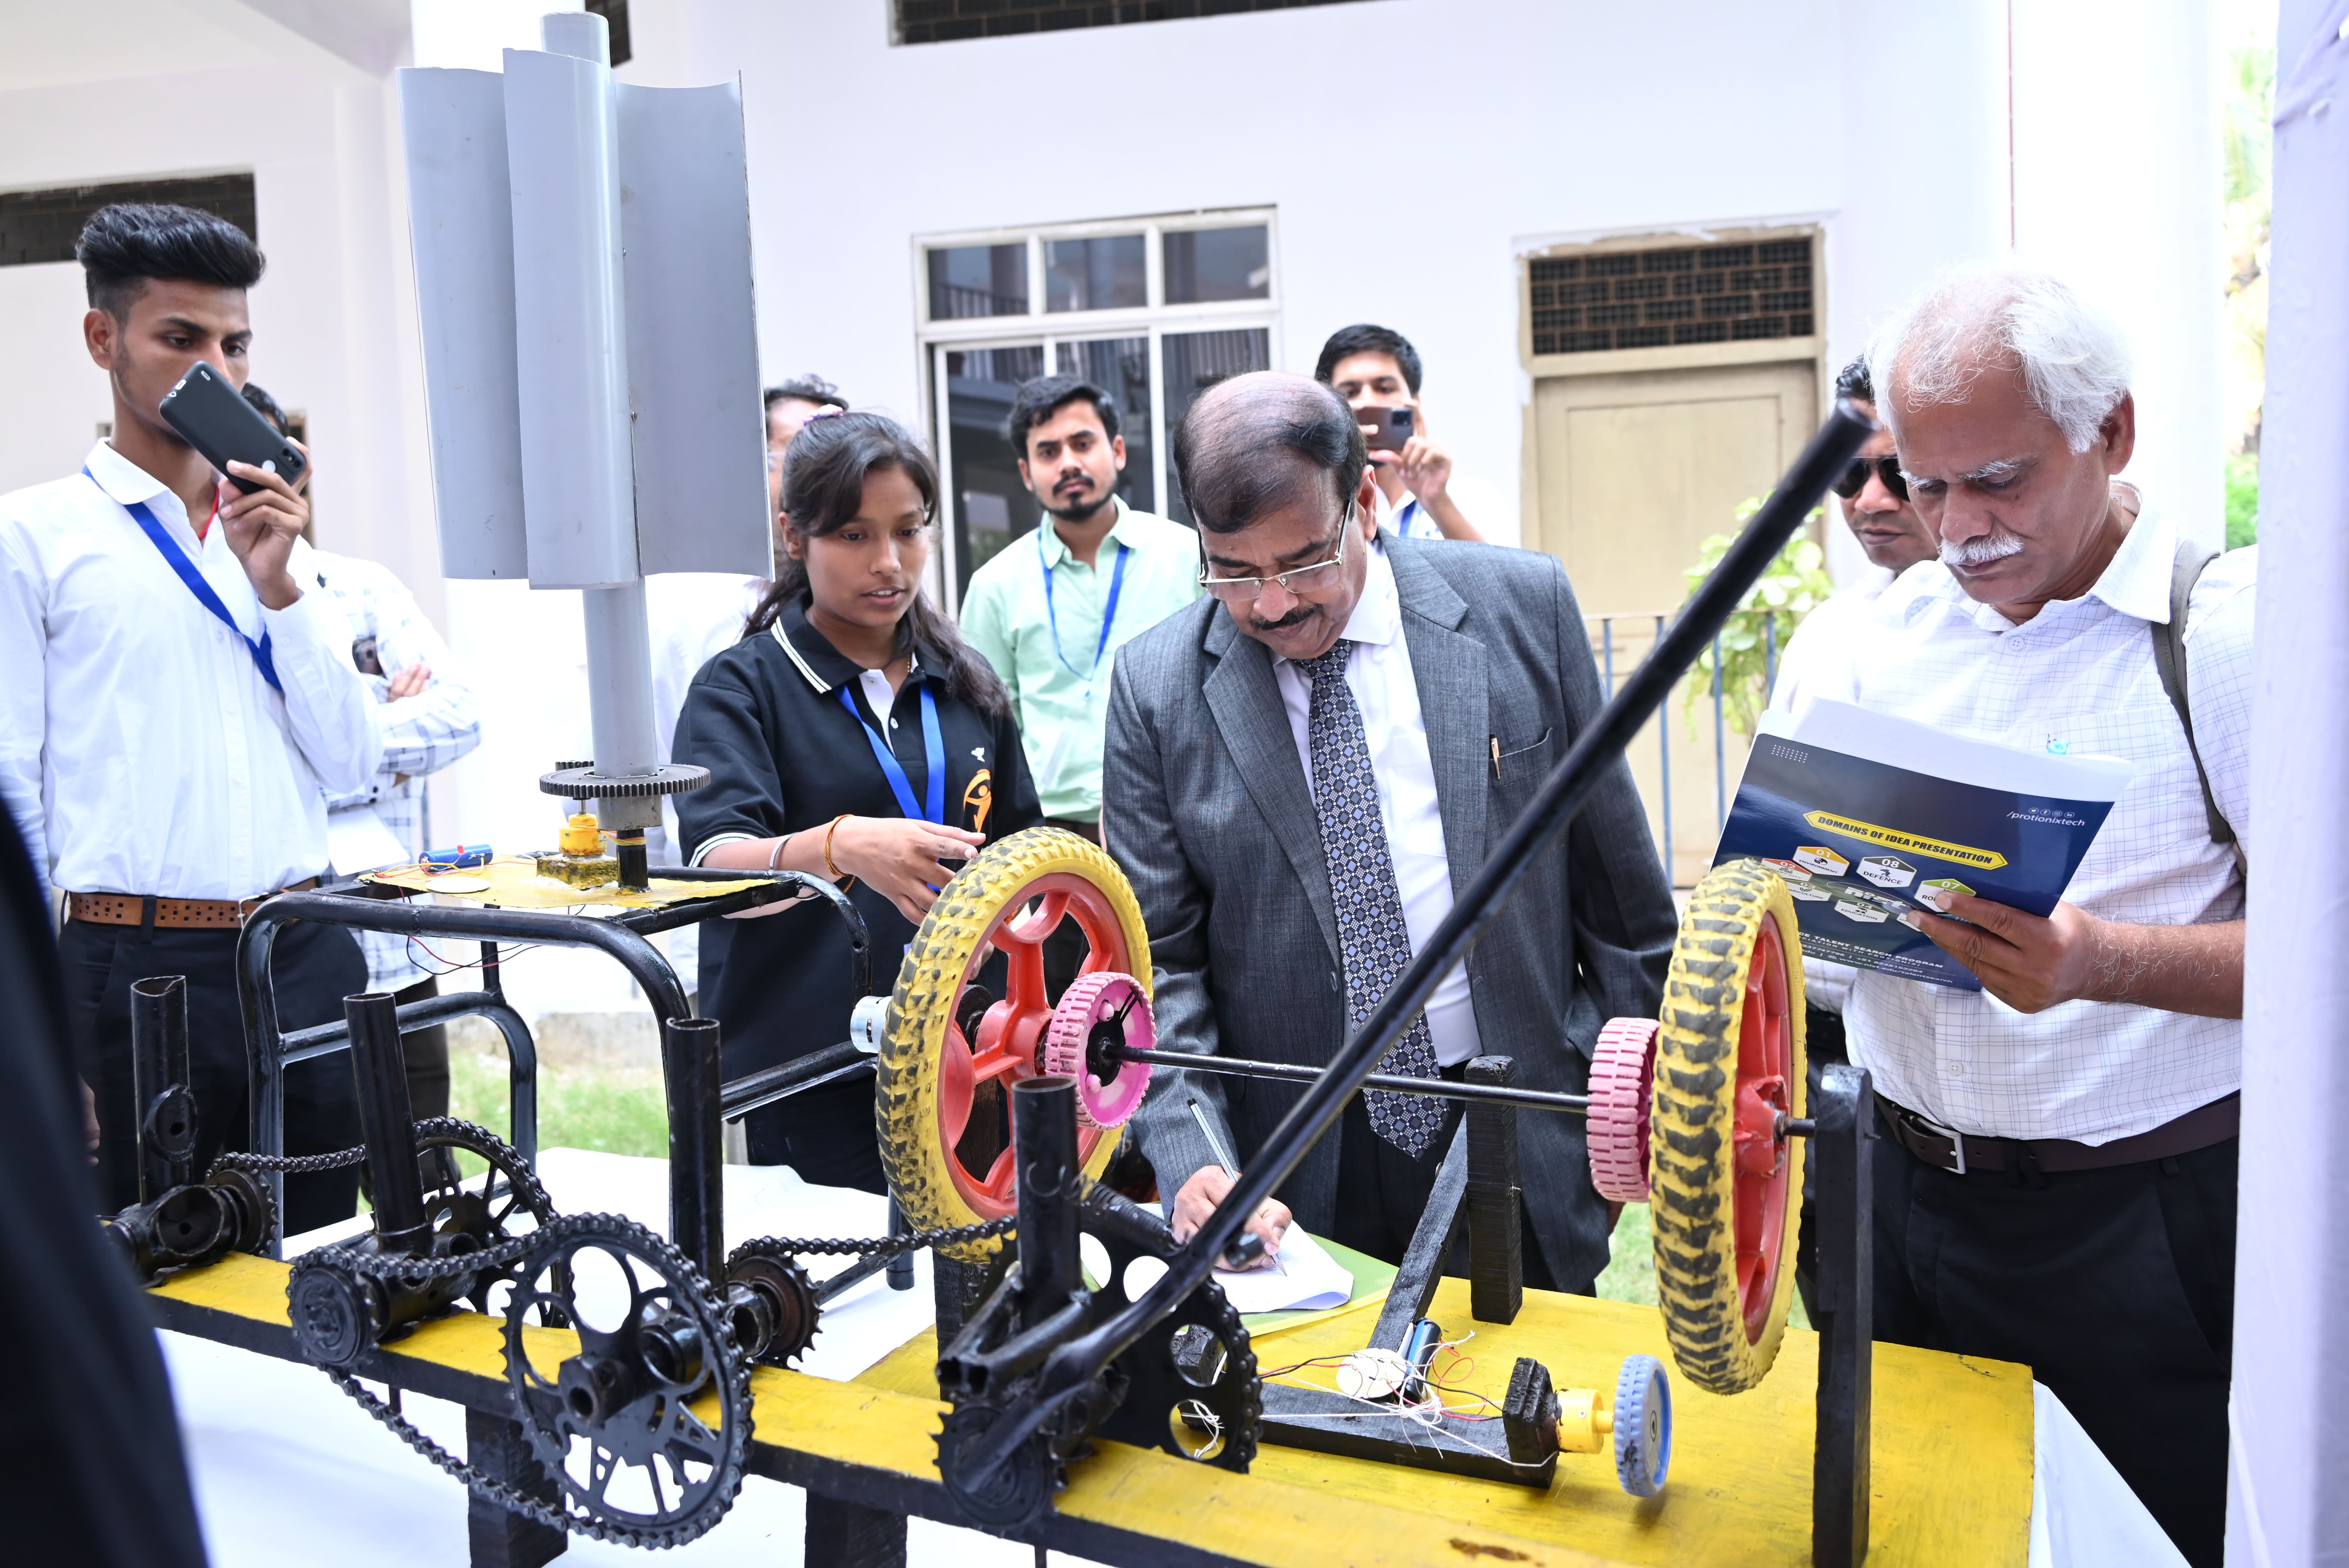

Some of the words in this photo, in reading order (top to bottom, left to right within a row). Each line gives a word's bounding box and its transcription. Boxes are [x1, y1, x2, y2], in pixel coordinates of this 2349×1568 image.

[2006, 811, 2085, 826] /protionixtech
[1818, 816, 1869, 836] DOMAINS
[1870, 830, 1885, 839] OF
[1885, 834, 1911, 846] IDEA
[1912, 841, 1993, 864] PRESENTATION
[1816, 849, 1831, 858] 01
[1780, 861, 1796, 870] 02
[1799, 859, 1838, 874] ENVIRONMENT
[1882, 858, 1900, 868] 08
[1863, 871, 1903, 885] DEFENCE
[1941, 881, 1960, 889] 07
[1788, 889, 1824, 900] GRICULTURE
[1844, 886, 1907, 909] nist
[1841, 908, 1878, 920] EDUCATION
[1799, 936, 1838, 948] CIATION
[1802, 944, 1845, 957] 937747796
[1814, 935, 1851, 947] TALENT
[1854, 946, 1892, 957] SEARCH
[1895, 955, 1943, 968] PROGRAM
